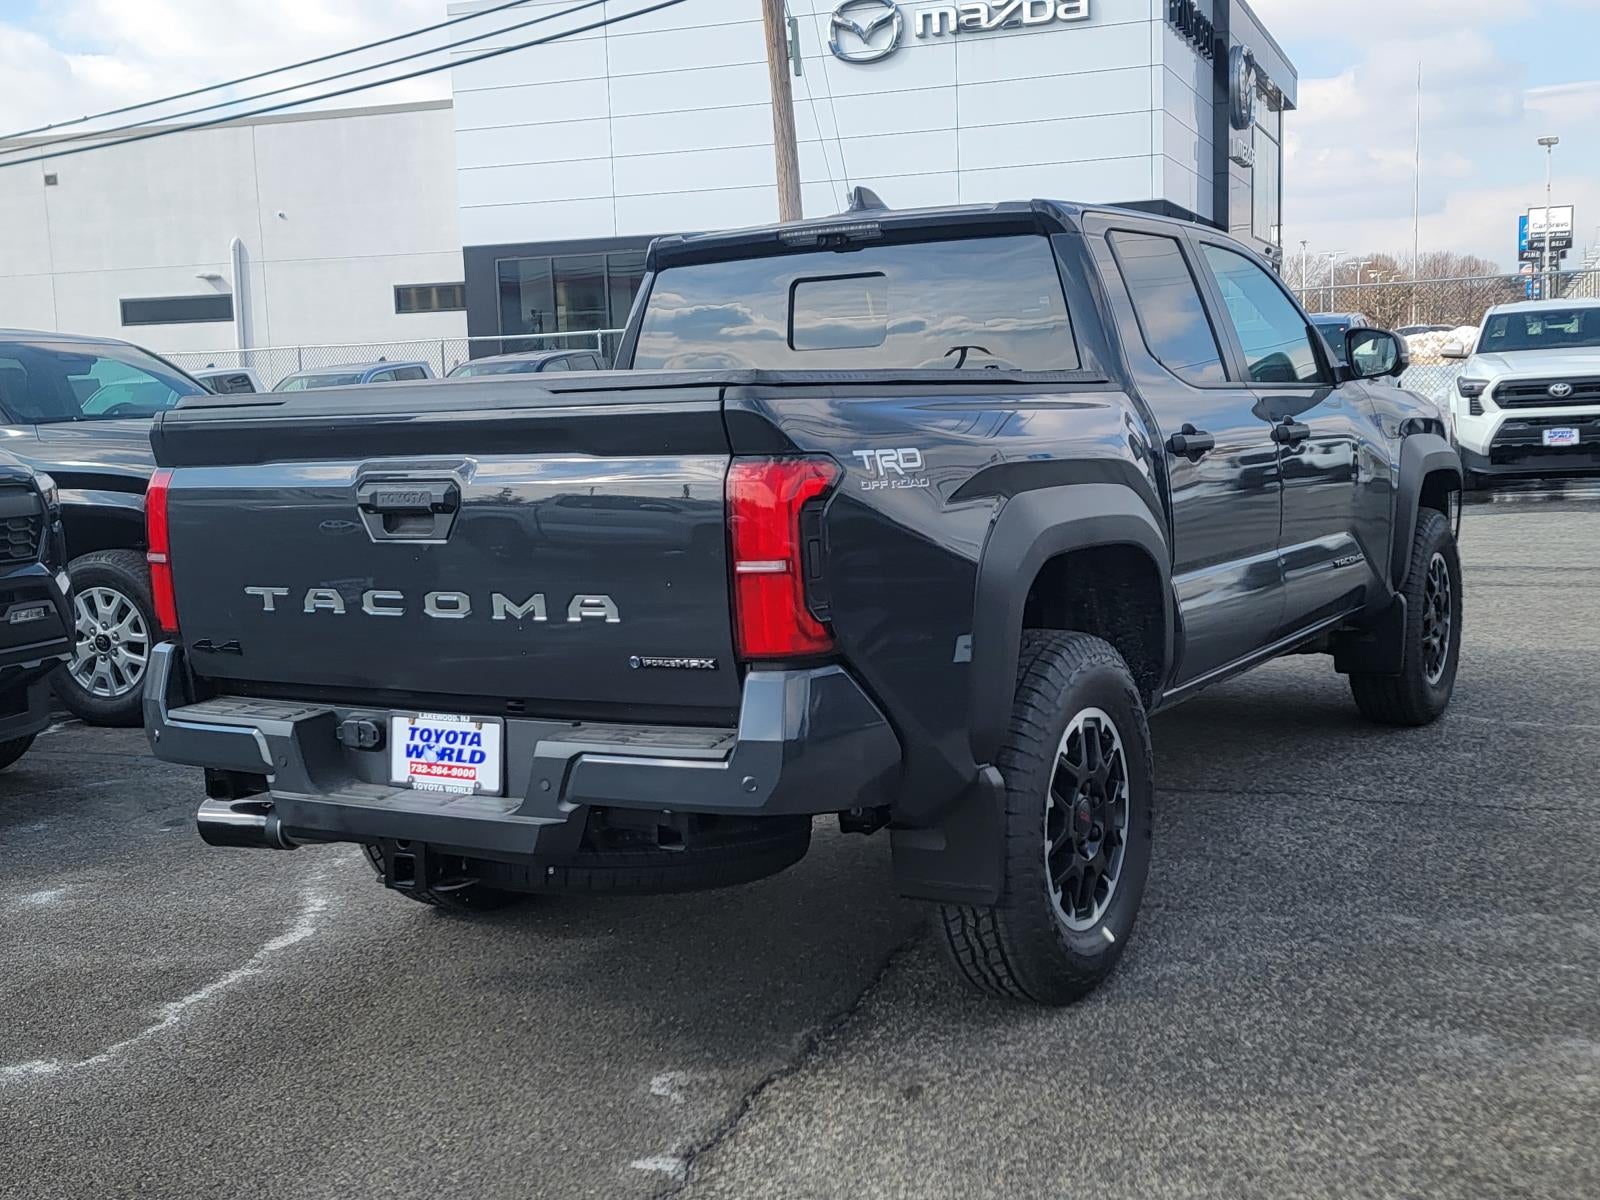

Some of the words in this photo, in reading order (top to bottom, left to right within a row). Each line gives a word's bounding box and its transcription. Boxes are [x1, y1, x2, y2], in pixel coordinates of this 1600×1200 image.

[852, 448, 922, 476] TRD
[380, 491, 430, 506] TOYOTA
[244, 585, 621, 624] TACOMA
[408, 727, 482, 747] TOYOTA
[410, 764, 475, 777] 732-364-9000
[412, 783, 444, 791] TOYOTA
[445, 785, 474, 795] WORLD
